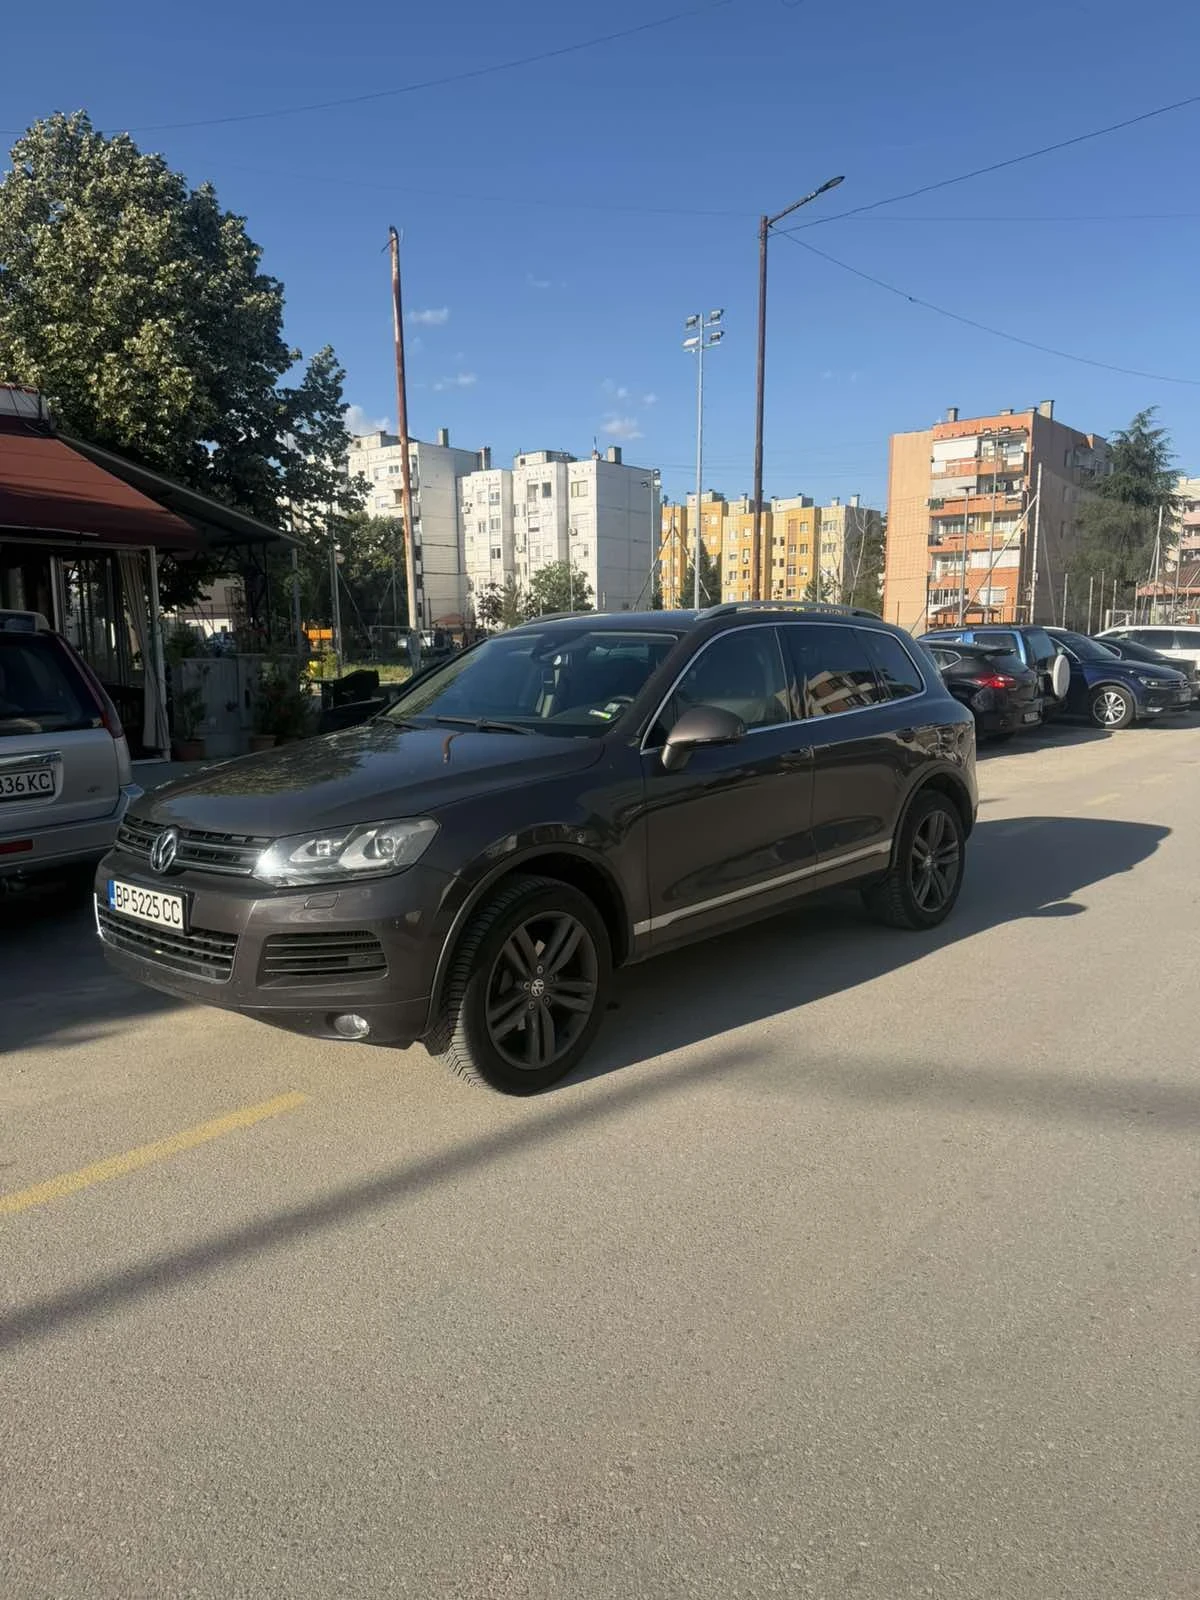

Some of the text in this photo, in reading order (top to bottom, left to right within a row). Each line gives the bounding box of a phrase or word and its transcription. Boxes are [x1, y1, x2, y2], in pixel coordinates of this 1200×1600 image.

[27, 773, 50, 791] KC
[116, 885, 180, 924] BP 5225 CC
